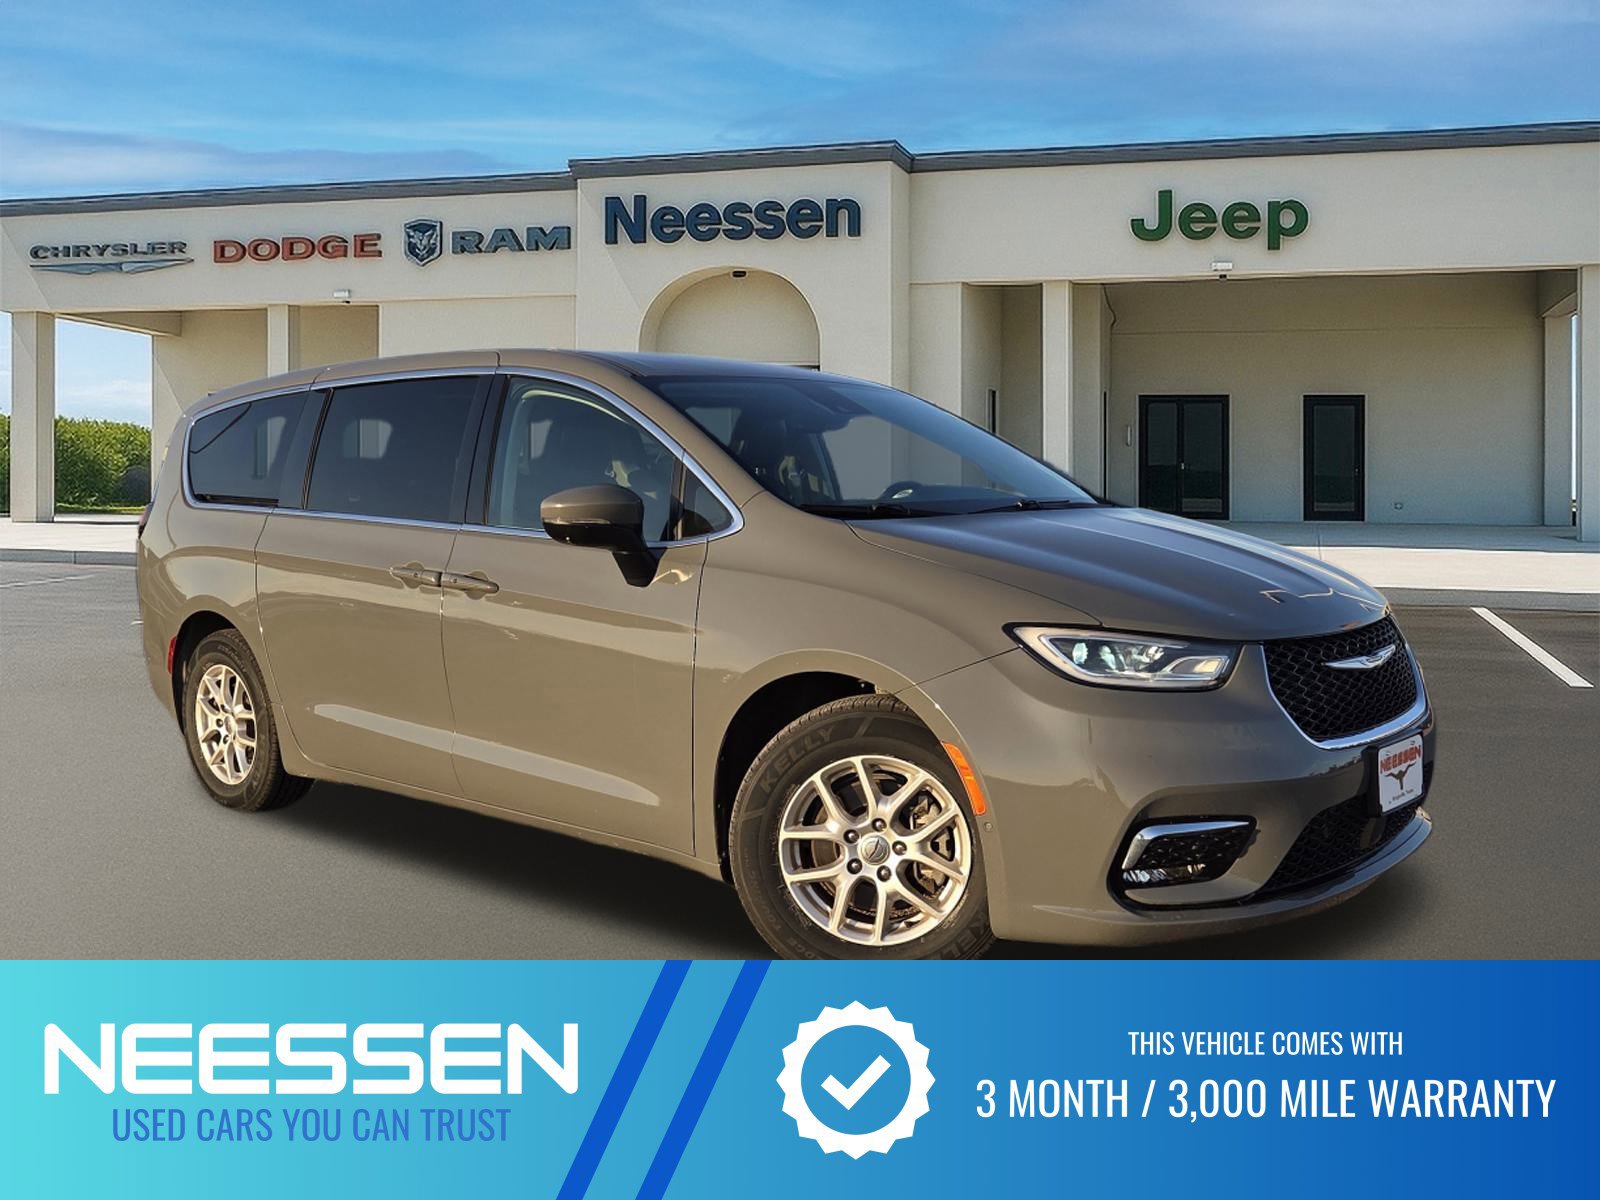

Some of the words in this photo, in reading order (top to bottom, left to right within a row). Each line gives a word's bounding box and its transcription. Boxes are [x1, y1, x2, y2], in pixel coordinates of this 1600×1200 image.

[451, 225, 571, 255] RAM
[604, 194, 862, 245] Neessen
[1130, 189, 1309, 251] Jeep
[29, 240, 188, 260] CHRYSLER
[213, 233, 382, 264] DODGE
[760, 727, 833, 792] KELLY
